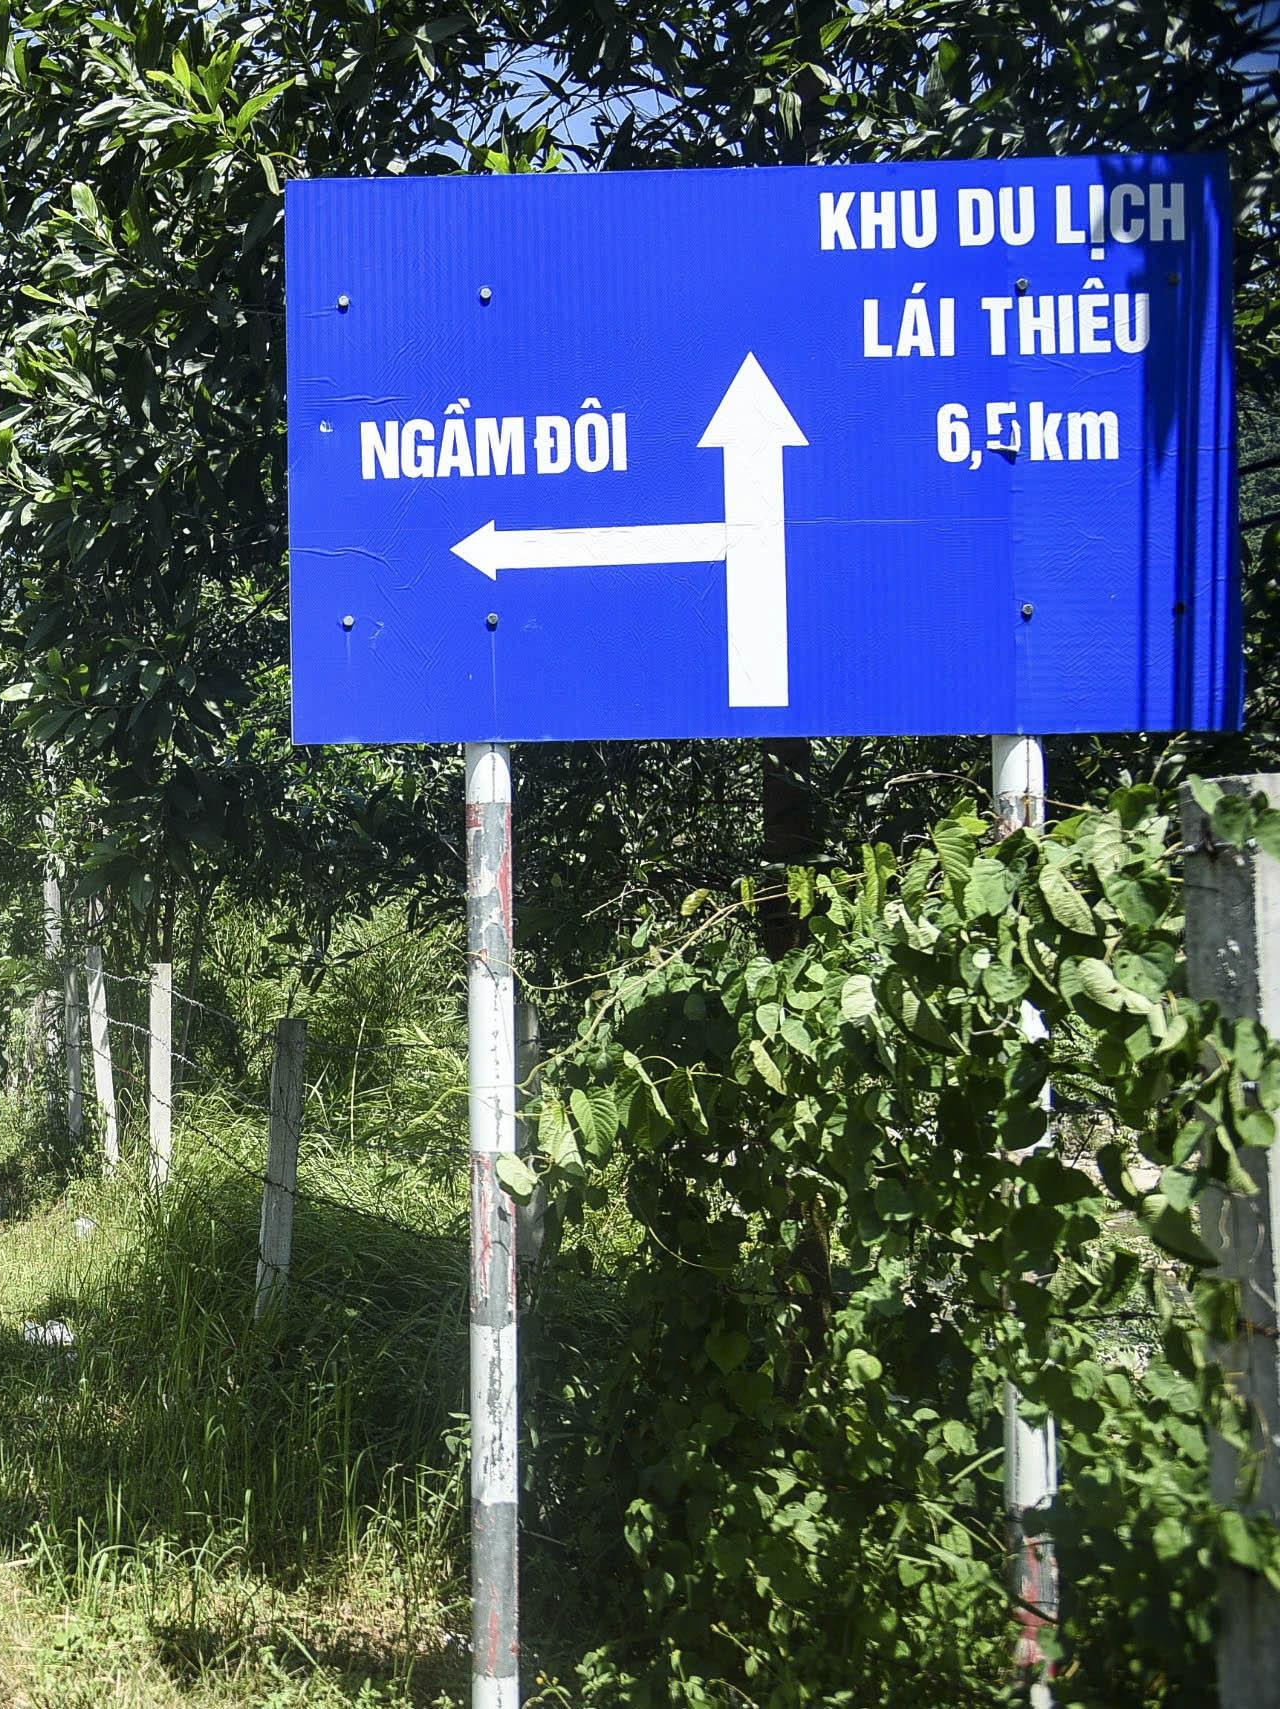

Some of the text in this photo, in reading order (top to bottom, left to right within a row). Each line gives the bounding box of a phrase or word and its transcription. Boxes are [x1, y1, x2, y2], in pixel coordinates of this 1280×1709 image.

[819, 182, 1186, 261] KHU DU LỊCH
[862, 276, 1151, 358] LÁI THIÊU
[359, 396, 628, 480] NGẦM ĐÔI
[1028, 400, 1120, 461] km
